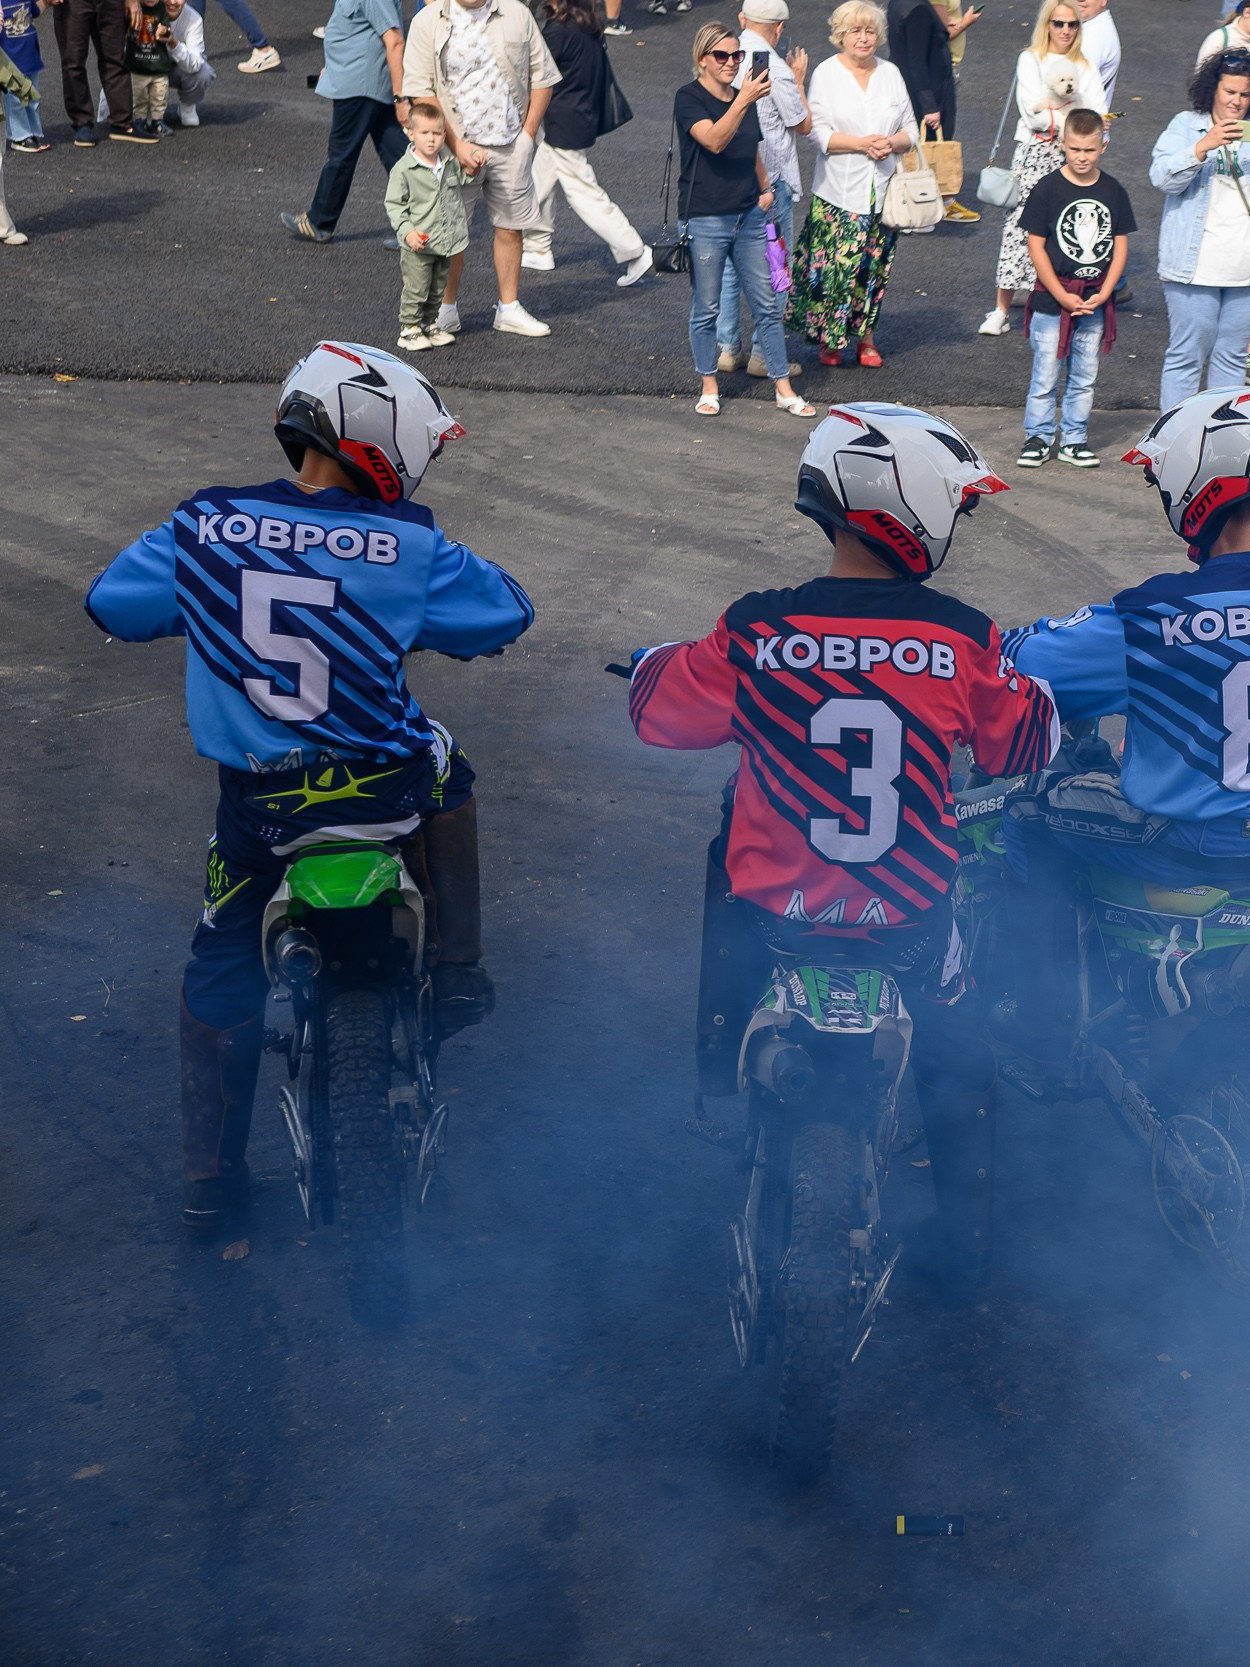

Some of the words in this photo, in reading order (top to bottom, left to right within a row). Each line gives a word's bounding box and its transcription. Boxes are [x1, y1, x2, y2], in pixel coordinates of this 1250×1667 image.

[362, 447, 399, 494] MOTS
[1184, 480, 1223, 531] MOTS
[198, 513, 399, 564] КОВРОВ
[870, 512, 924, 560] MOTS
[241, 568, 337, 722] 5
[756, 633, 956, 679] КОВРОВ
[810, 698, 903, 863] 3
[790, 974, 808, 1006] DUNLOP
